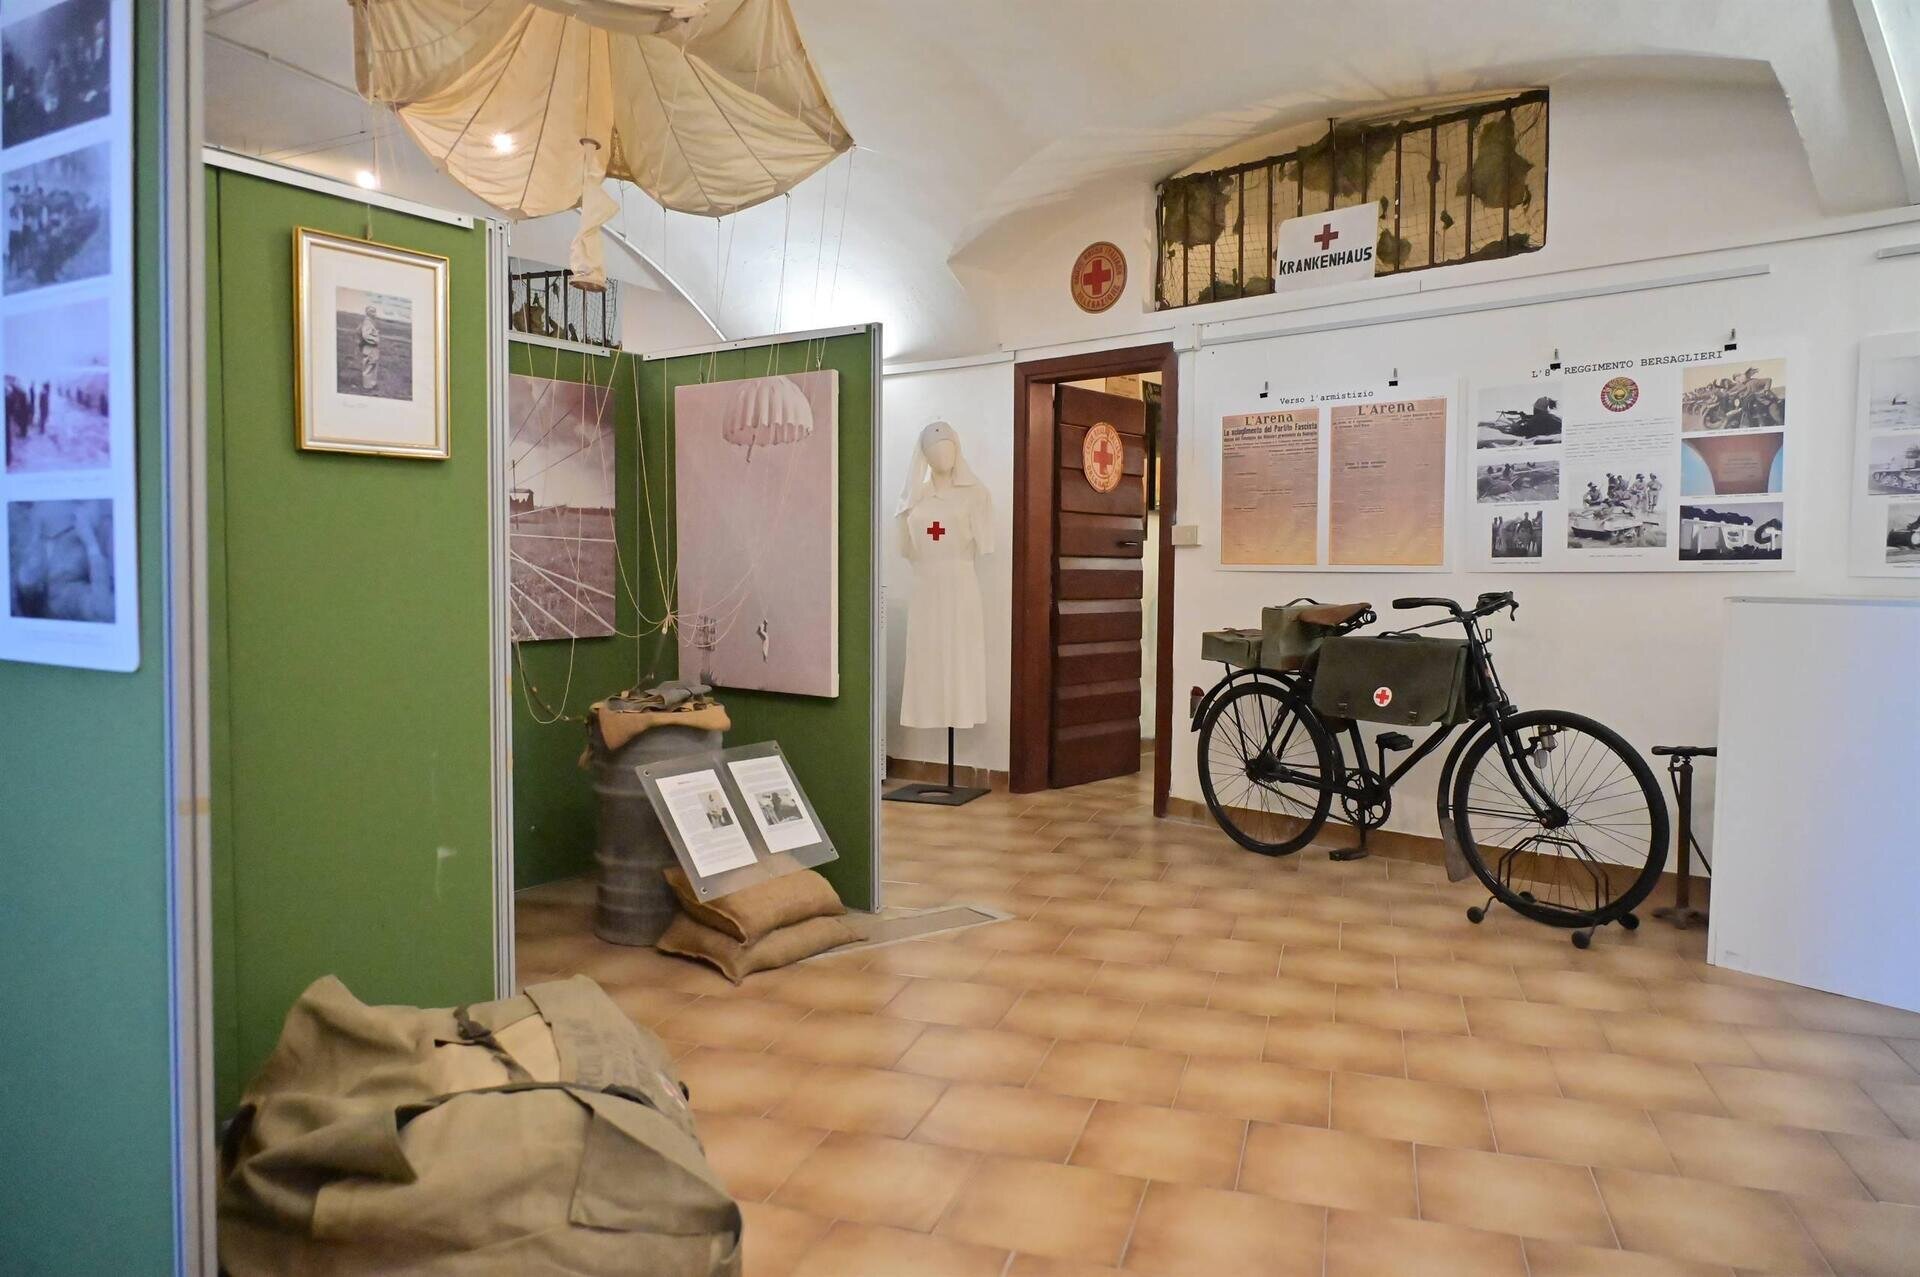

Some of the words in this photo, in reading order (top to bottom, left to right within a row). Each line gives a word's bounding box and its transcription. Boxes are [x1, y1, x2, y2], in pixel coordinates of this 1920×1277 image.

[1279, 246, 1373, 275] KRANKENHAUS
[1531, 368, 1556, 378] L'8
[1564, 360, 1634, 375] REGGIMENTO
[1640, 350, 1723, 366] BERSAGLIERI
[1280, 397, 1305, 405] Verso
[1310, 391, 1374, 402] l'armistizio
[1357, 402, 1415, 416] L'Arena
[1245, 413, 1294, 426] L'Arena
